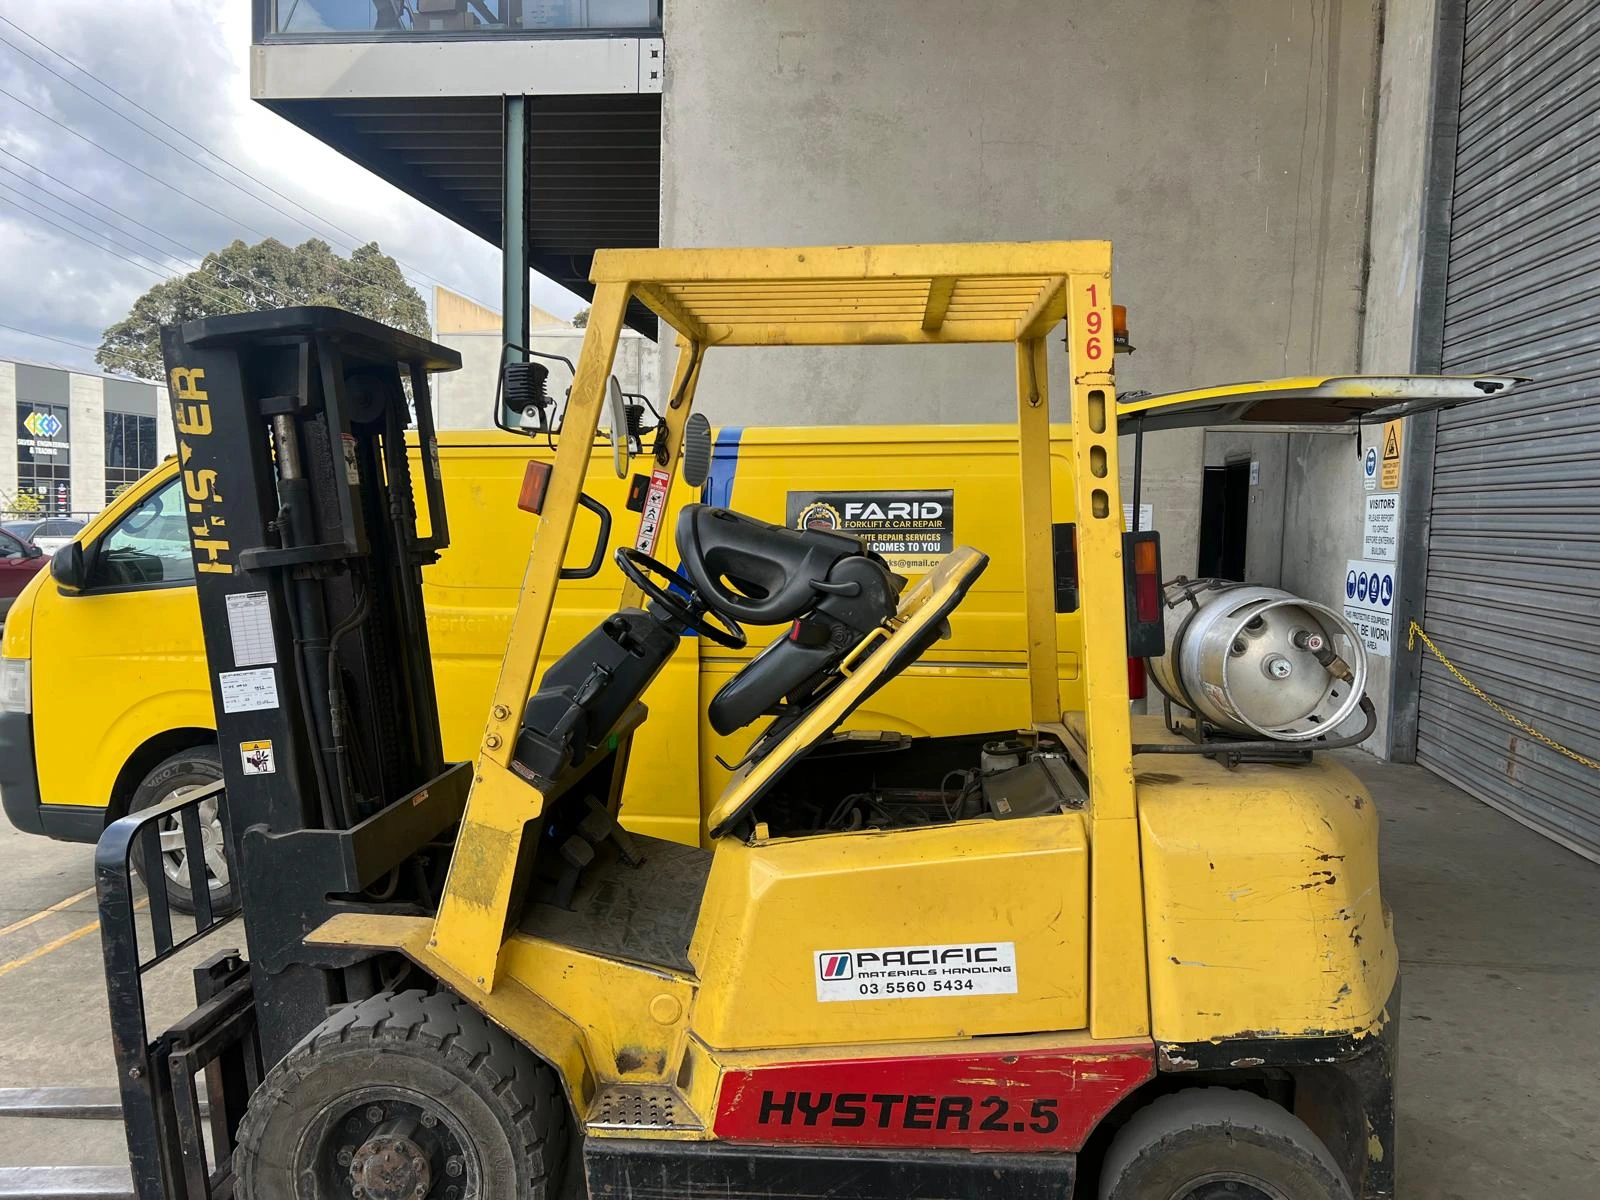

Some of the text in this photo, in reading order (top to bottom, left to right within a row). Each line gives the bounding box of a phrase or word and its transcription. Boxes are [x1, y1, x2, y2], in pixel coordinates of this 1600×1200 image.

[1086, 284, 1102, 360] 196
[170, 367, 233, 574] HSER
[1369, 498, 1395, 509] VISITORS
[845, 502, 943, 520] FARID
[1368, 513, 1394, 522] PLEASE REPORT
[845, 520, 943, 528] FORKLIFT & CAR REPAIR
[877, 533, 904, 541] REPAIR
[905, 533, 941, 541] SERVICES
[1365, 535, 1395, 545] BEFORE ENTERING
[872, 542, 905, 552] COMES
[907, 542, 919, 552] TO
[921, 542, 941, 552] YOU
[1352, 611, 1371, 622] PROTECTIVE
[1371, 615, 1390, 626] EQUIPMENT
[1361, 624, 1369, 636] BE
[1370, 626, 1390, 642] WORN
[1367, 640, 1377, 650] AREA
[856, 947, 998, 968] PACIFIC
[858, 965, 1011, 979] MATERIALS HANDLING
[859, 979, 973, 995] 03 5560 5434
[758, 1091, 1059, 1134] HYSTER 2.5
